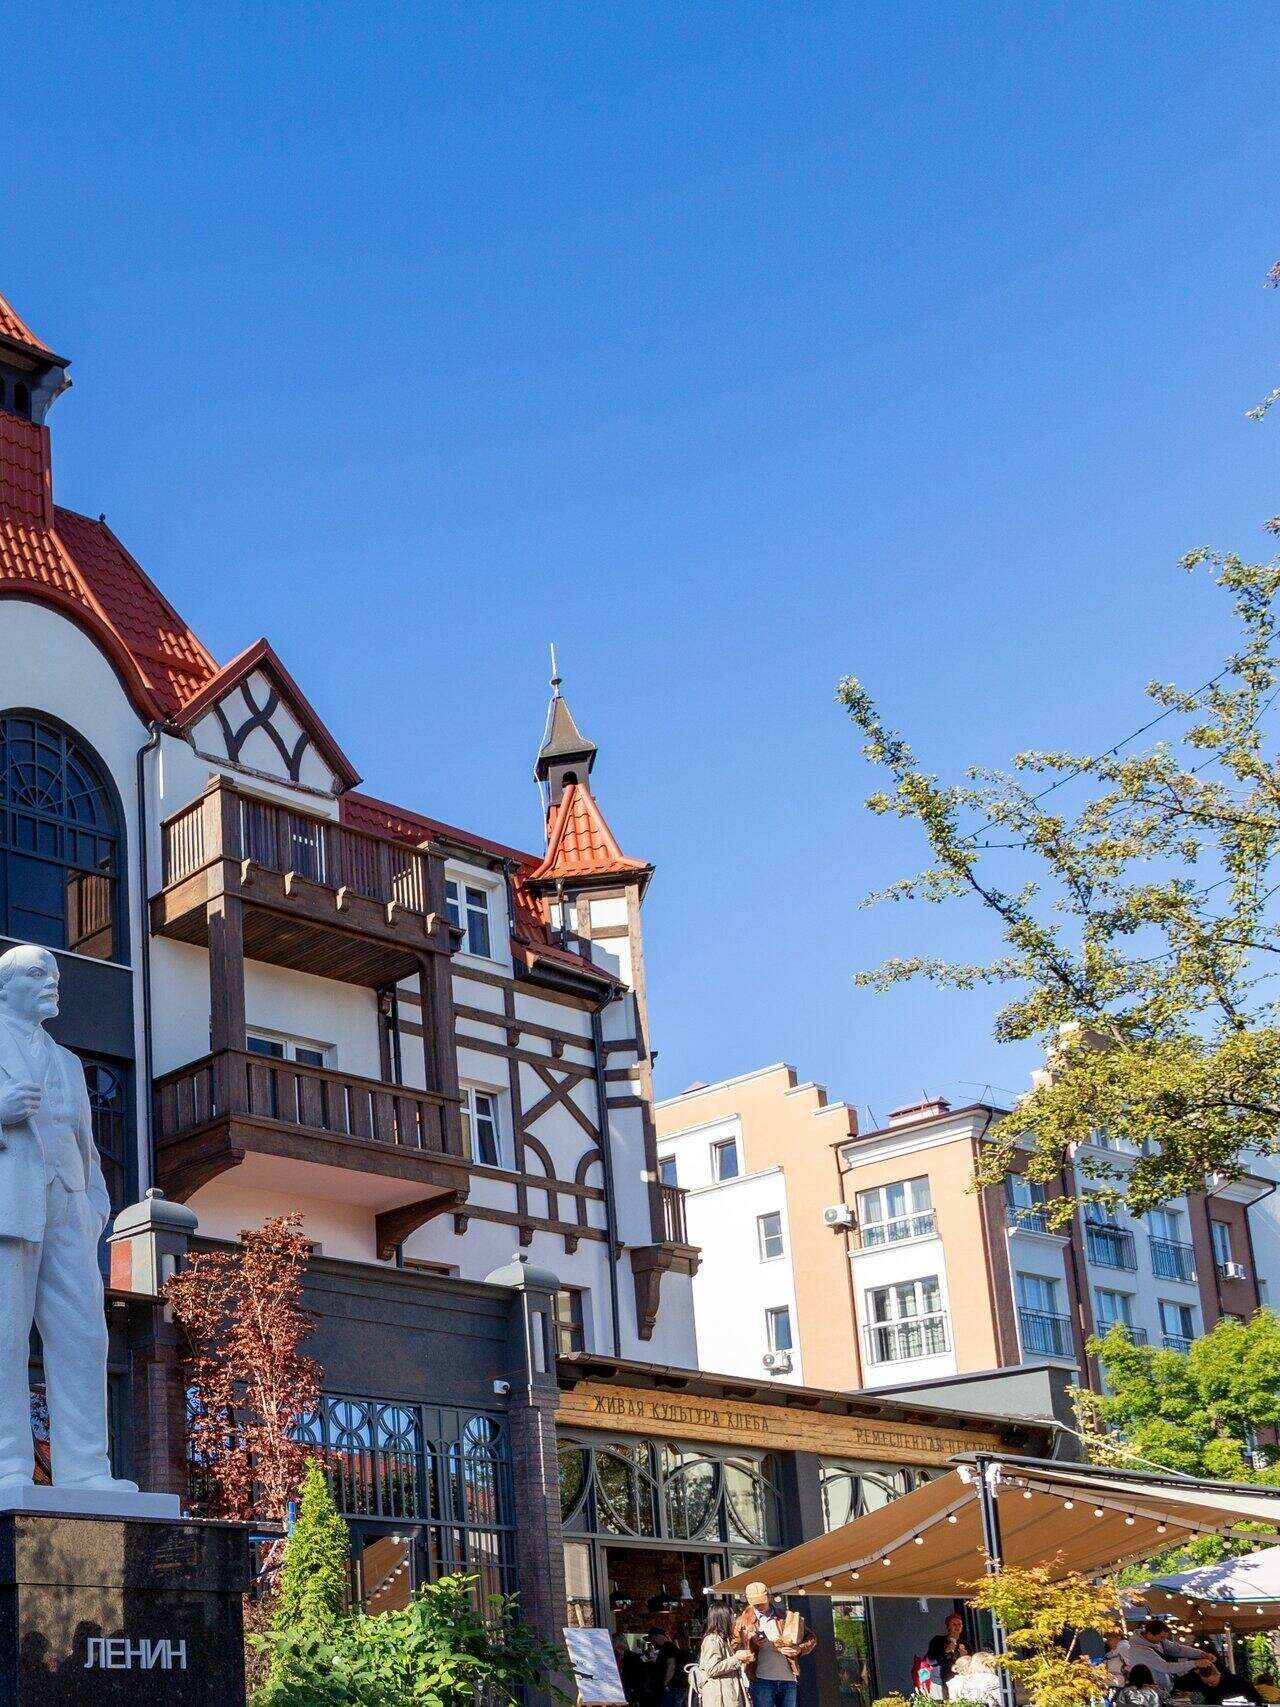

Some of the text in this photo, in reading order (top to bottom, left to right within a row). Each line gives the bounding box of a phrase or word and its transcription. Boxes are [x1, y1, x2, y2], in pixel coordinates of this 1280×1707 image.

[593, 1394, 769, 1432] ЖИВАЯ КУЛЬТУРА ХЛЕБА
[853, 1428, 943, 1452] РЕМЕСЛЕННАЯ
[83, 1637, 187, 1670] ЛЕНИН
